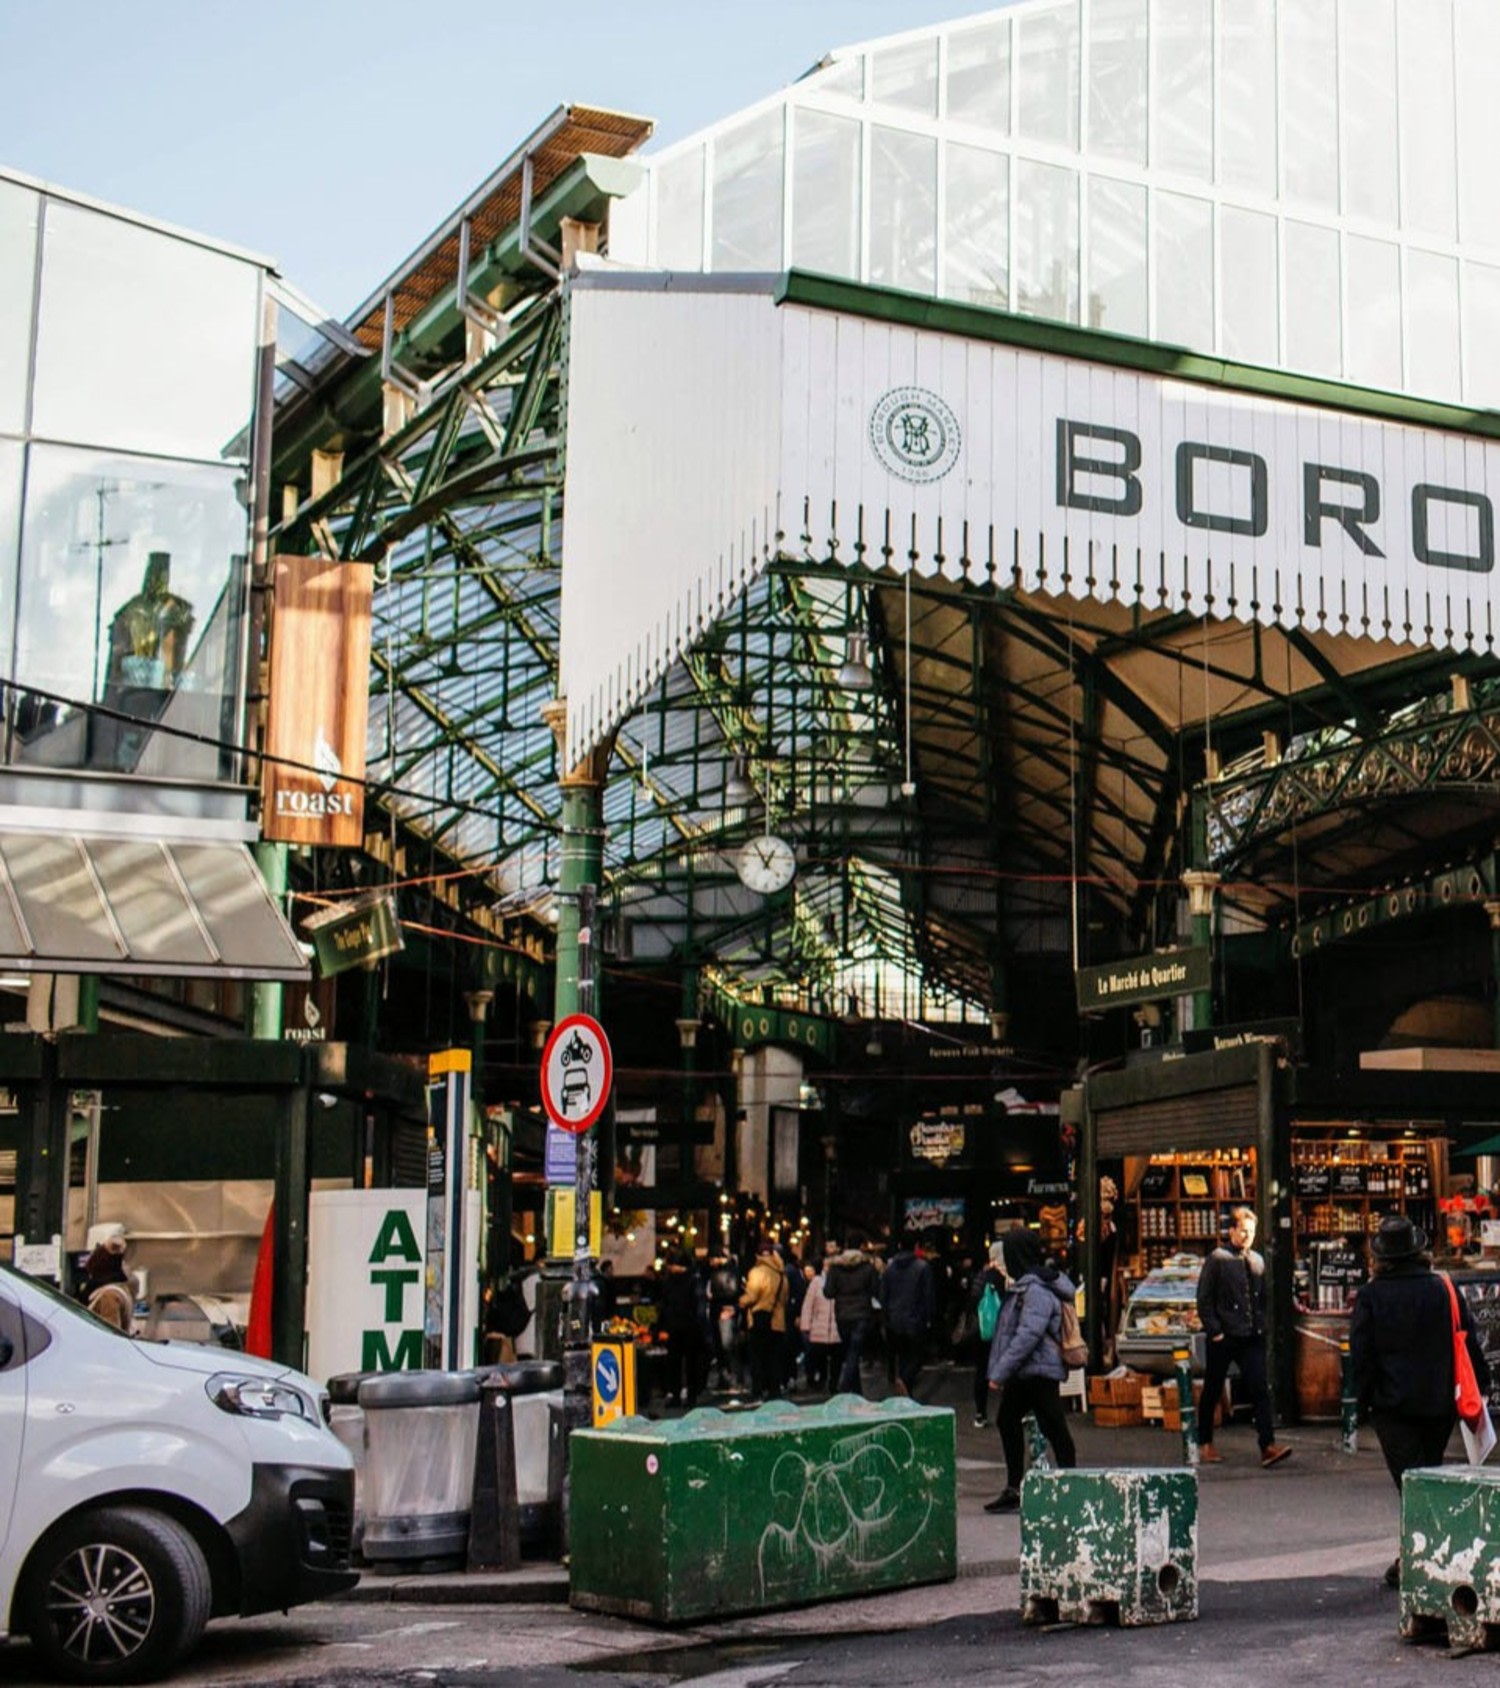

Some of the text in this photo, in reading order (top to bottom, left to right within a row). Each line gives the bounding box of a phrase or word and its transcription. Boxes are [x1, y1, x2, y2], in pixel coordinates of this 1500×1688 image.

[276, 790, 353, 815] roast
[1098, 963, 1187, 995] Le Marché du Quartier
[284, 1027, 326, 1041] roast
[361, 1209, 424, 1372] ATM
